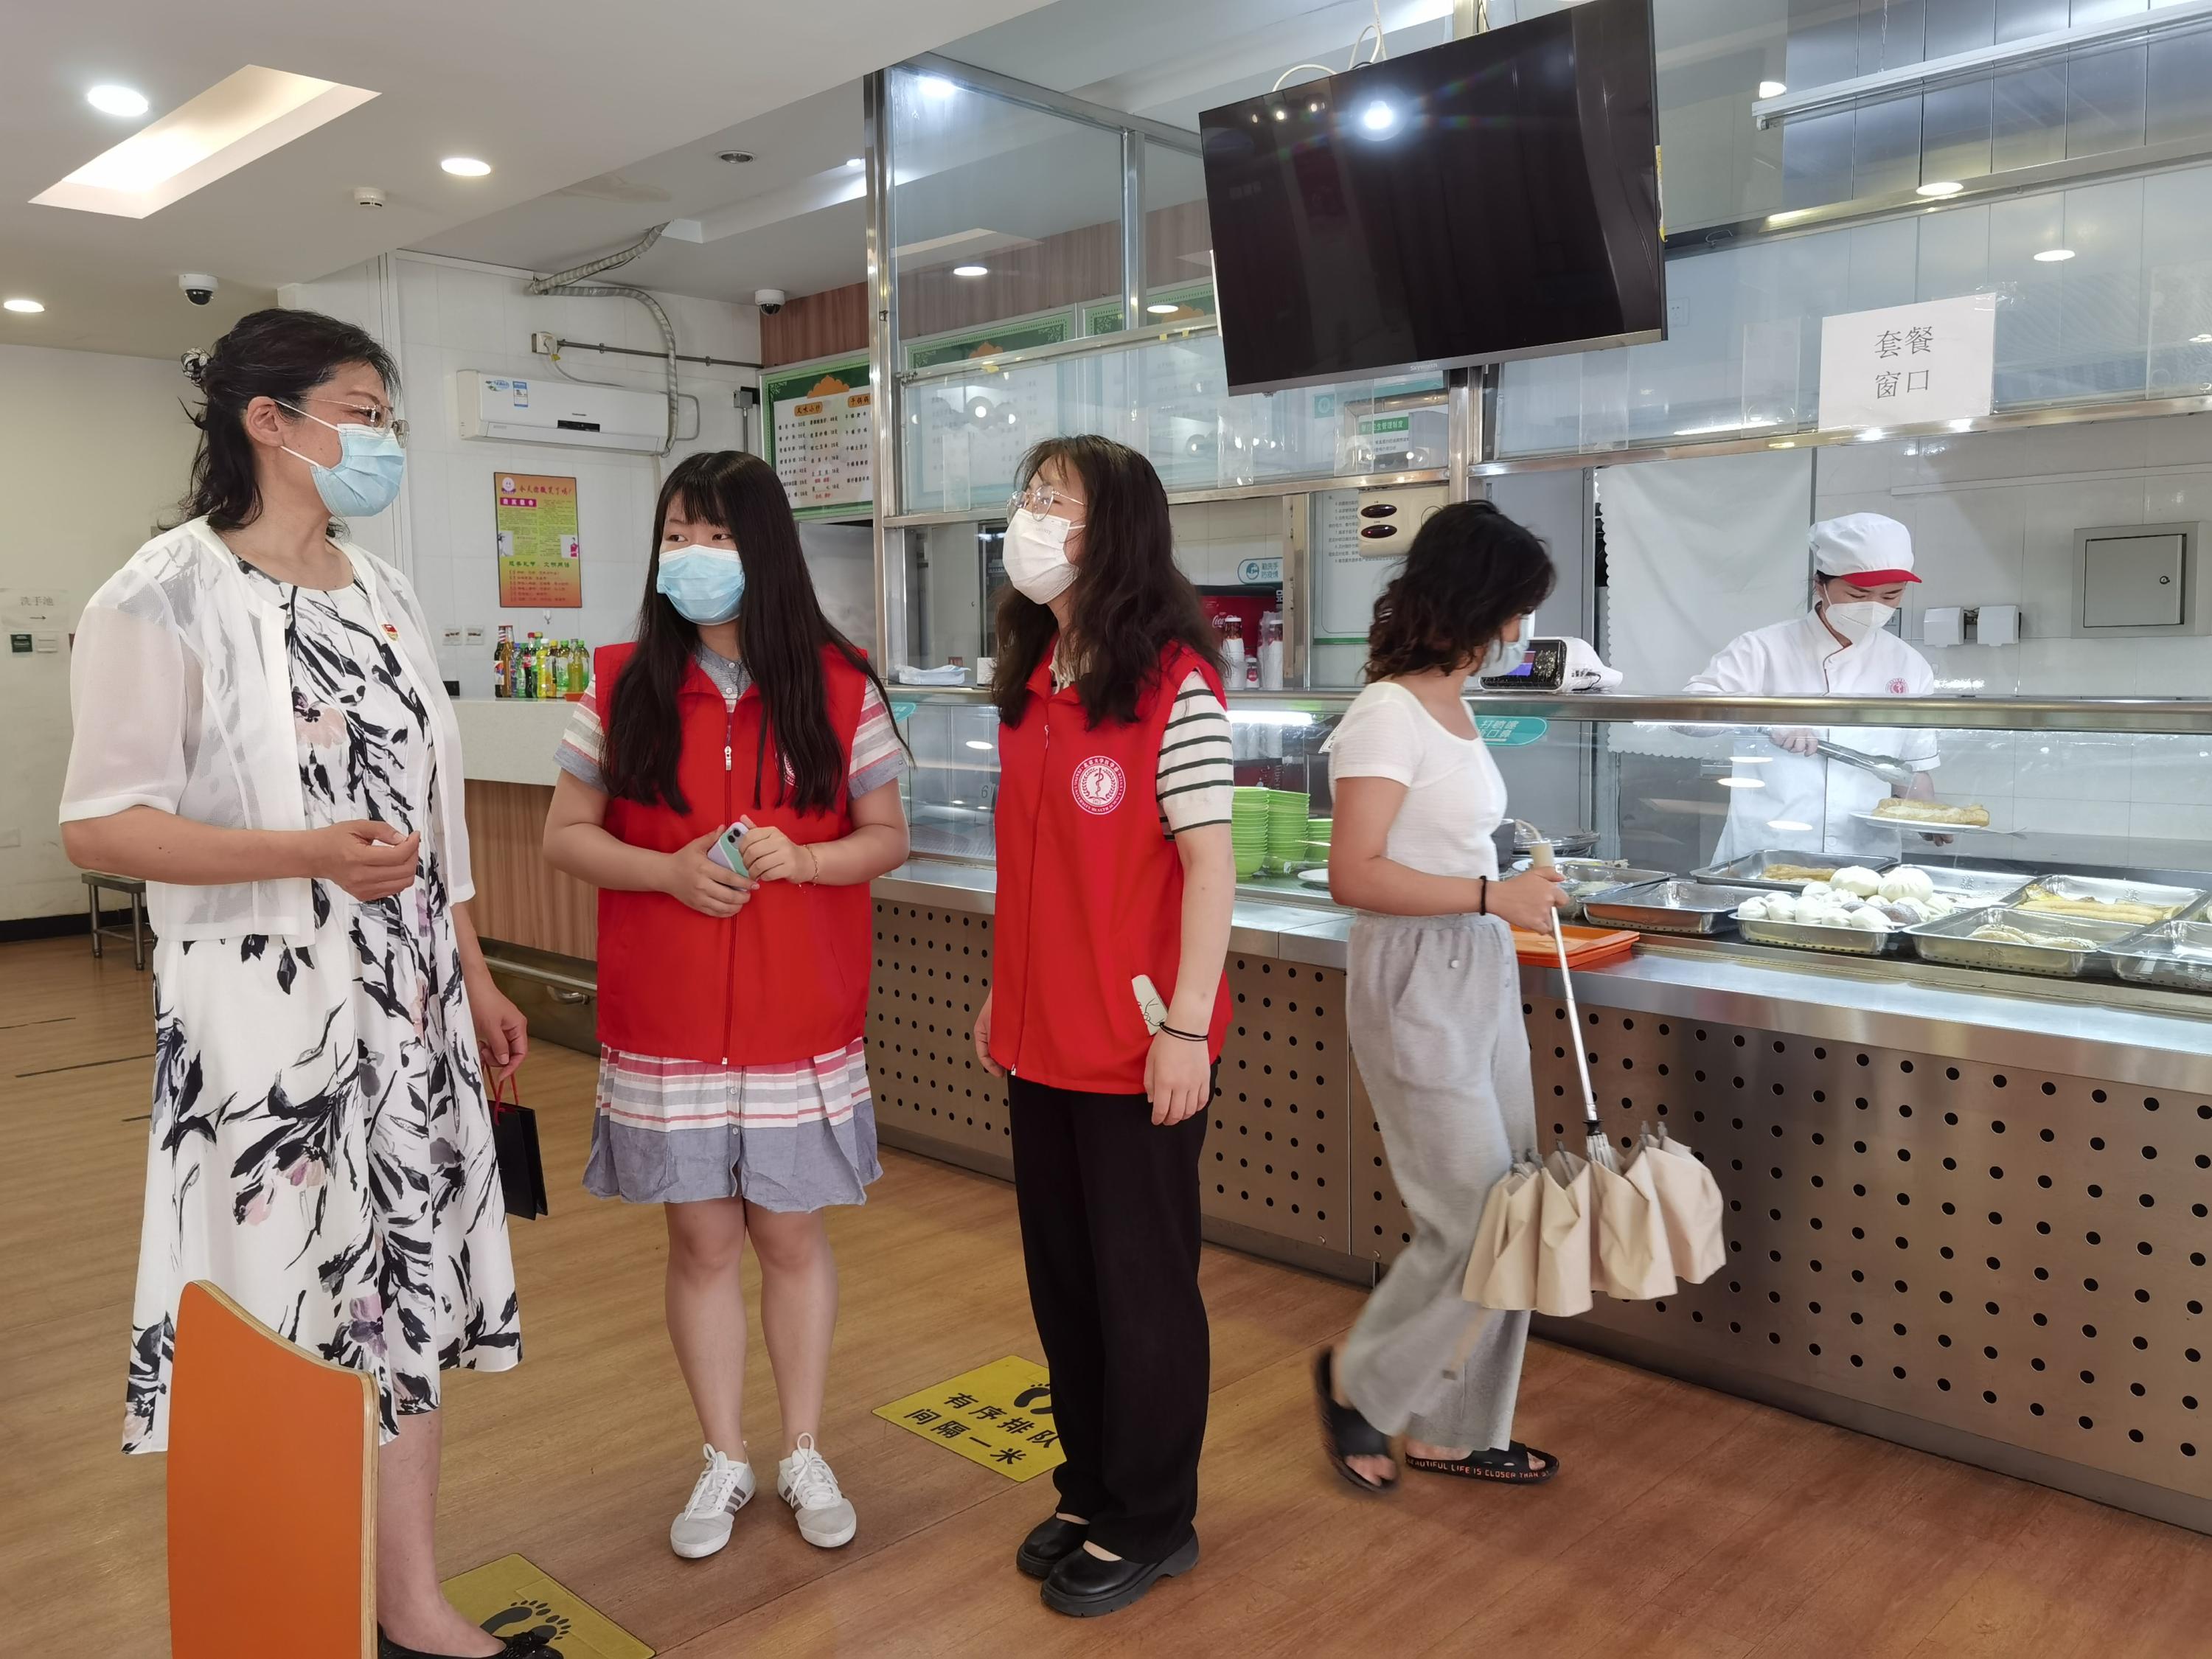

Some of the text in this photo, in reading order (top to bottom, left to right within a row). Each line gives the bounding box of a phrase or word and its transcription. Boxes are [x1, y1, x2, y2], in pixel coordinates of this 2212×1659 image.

[1874, 326, 1933, 359] 套餐
[1875, 370, 1929, 399] 窗口
[20, 597, 54, 606] 洗手池
[1480, 720, 1519, 729] 打喷嚏
[944, 1393, 1060, 1448] 有序排队
[903, 1409, 1026, 1464] 间隔一米
[1451, 1464, 1470, 1474] LIFE
[1474, 1467, 1482, 1475] IS
[1485, 1469, 1516, 1479] CLOSER
[1520, 1471, 1539, 1479] THAN
